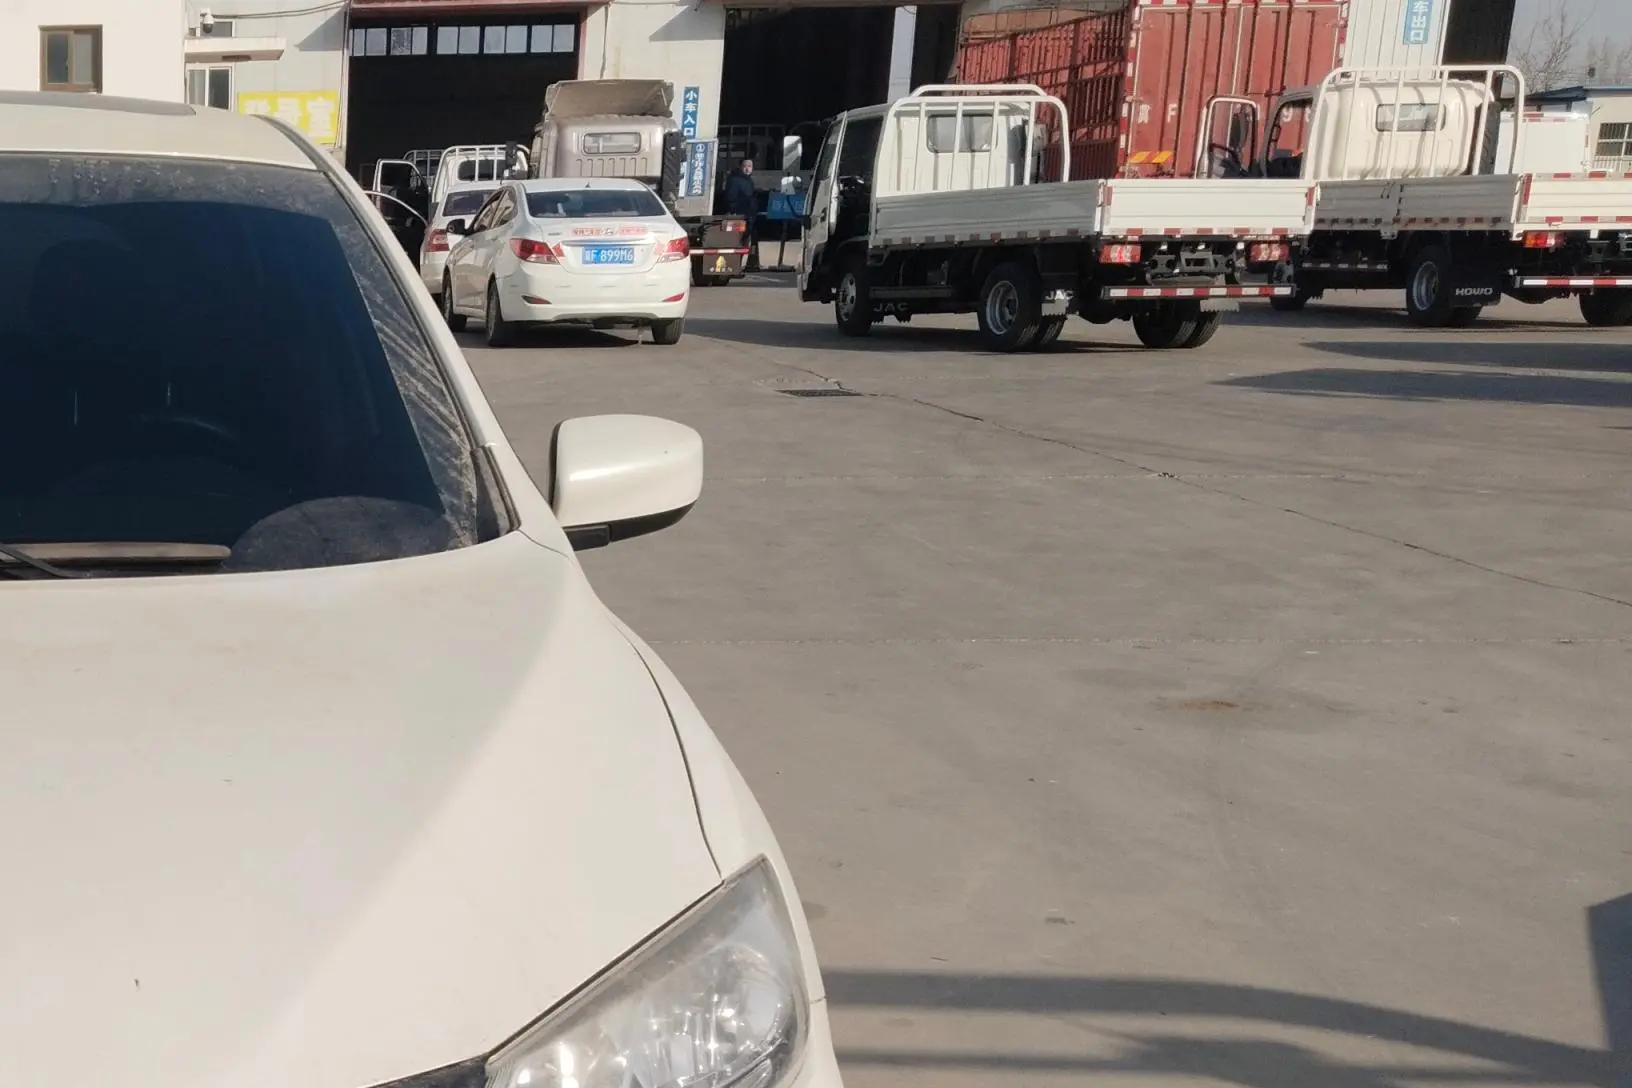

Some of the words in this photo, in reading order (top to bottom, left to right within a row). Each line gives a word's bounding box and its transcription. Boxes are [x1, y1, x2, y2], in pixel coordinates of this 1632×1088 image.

[683, 90, 698, 136] 小车入口
[1044, 289, 1075, 301] JAC
[1455, 287, 1494, 296] HOWO
[873, 302, 909, 312] JAC
